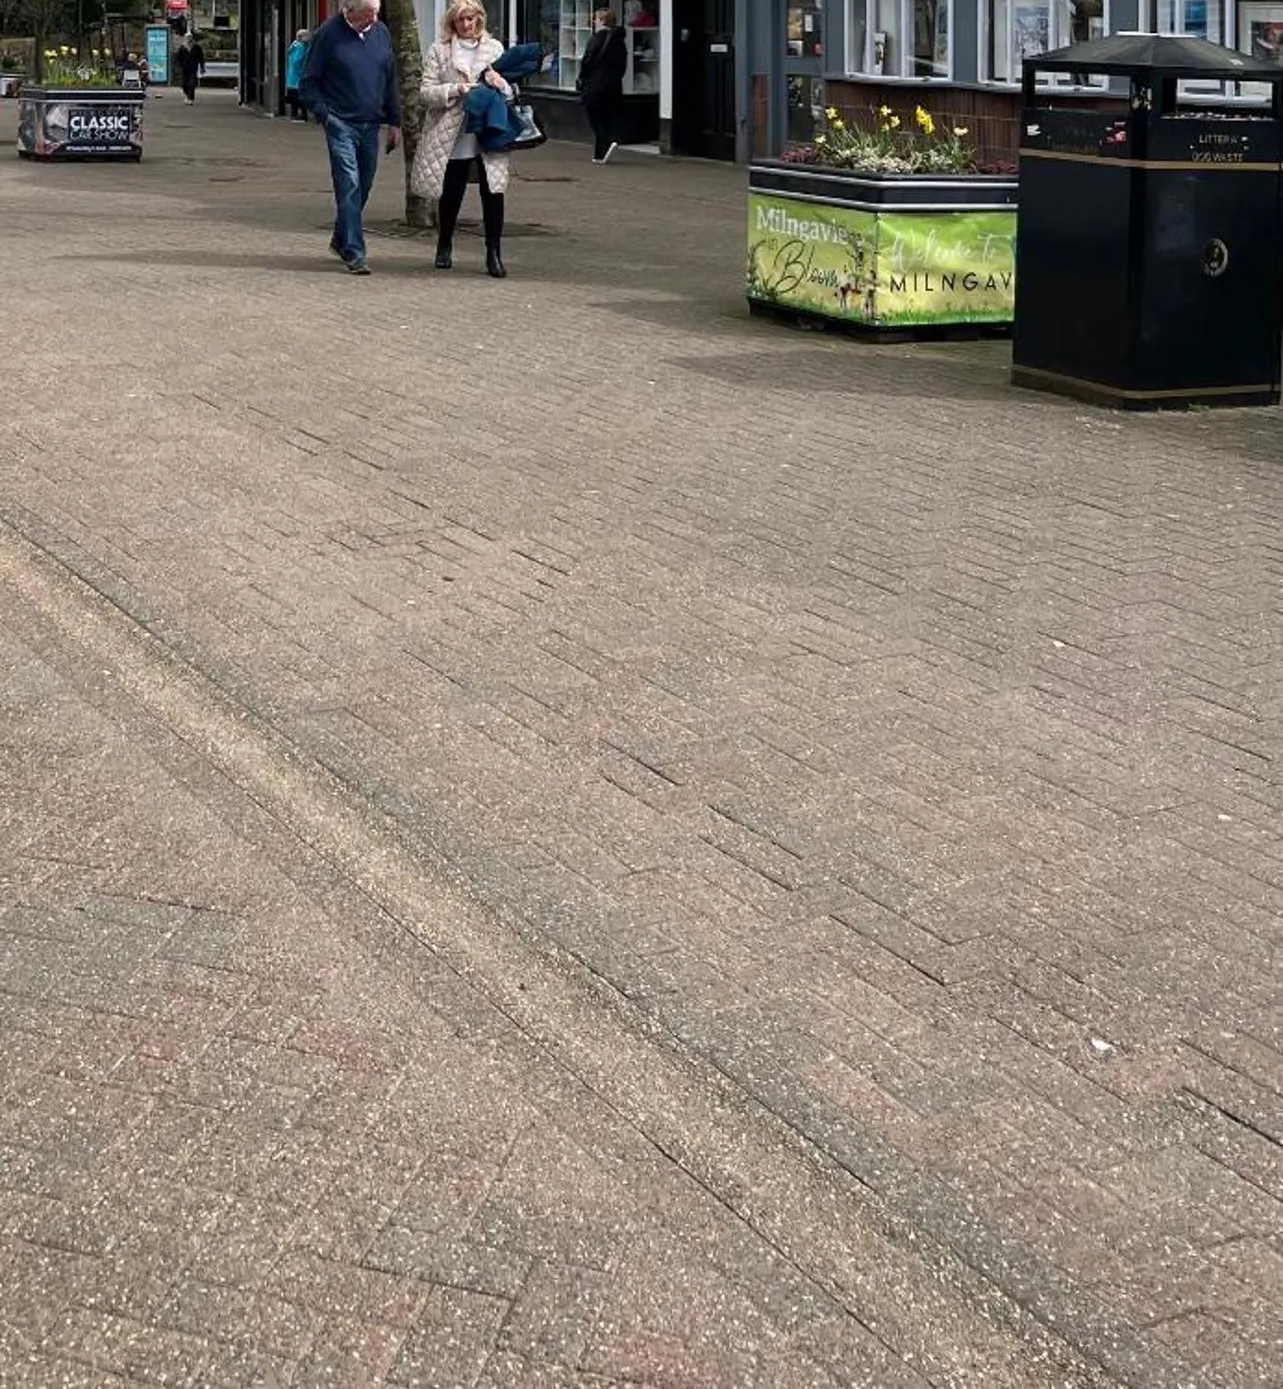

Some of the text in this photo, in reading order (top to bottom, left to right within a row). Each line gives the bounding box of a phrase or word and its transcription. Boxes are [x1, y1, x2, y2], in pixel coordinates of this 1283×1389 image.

[70, 116, 129, 130] CLASSIC
[94, 130, 129, 141] SHOW
[755, 205, 850, 245] Milngavie
[889, 271, 1012, 293] MILNGAV
